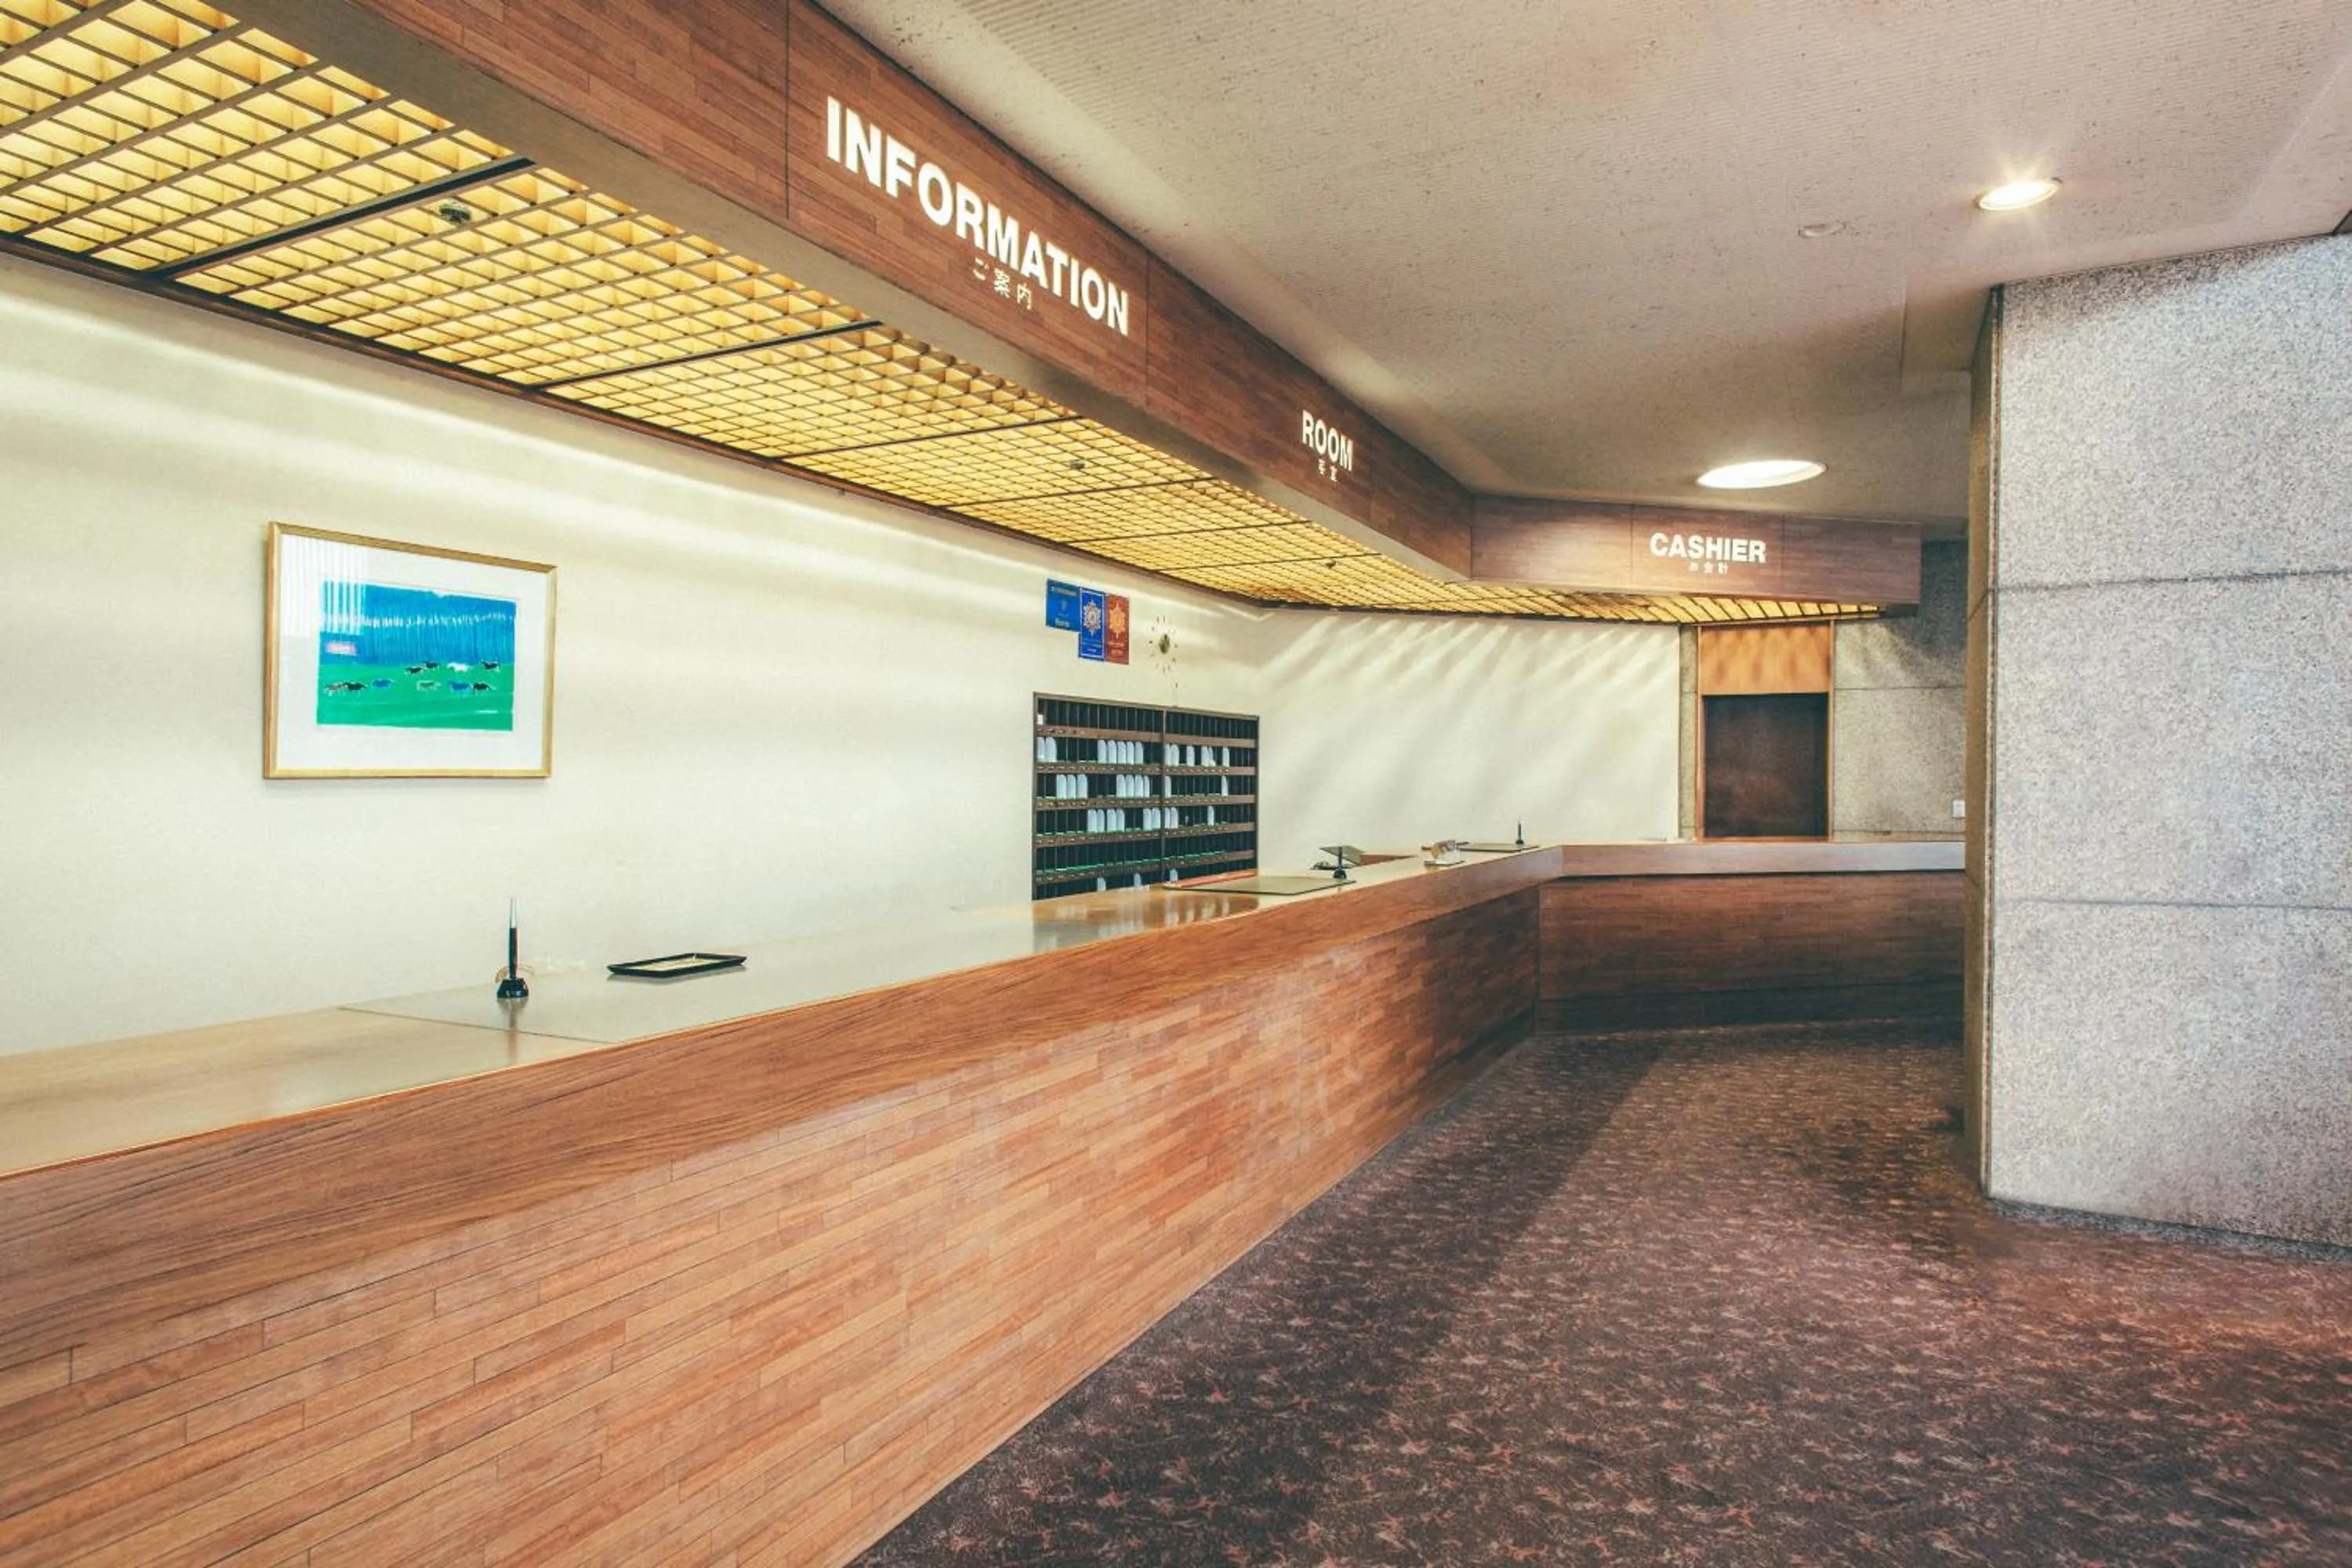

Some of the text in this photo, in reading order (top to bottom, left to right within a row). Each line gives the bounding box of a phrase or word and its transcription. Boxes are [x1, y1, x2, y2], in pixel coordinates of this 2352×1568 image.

[827, 96, 1128, 336] INFORMATION
[973, 257, 1032, 310] ご案内
[1302, 409, 1353, 471] ROOM
[1650, 532, 1766, 563] CASHIER
